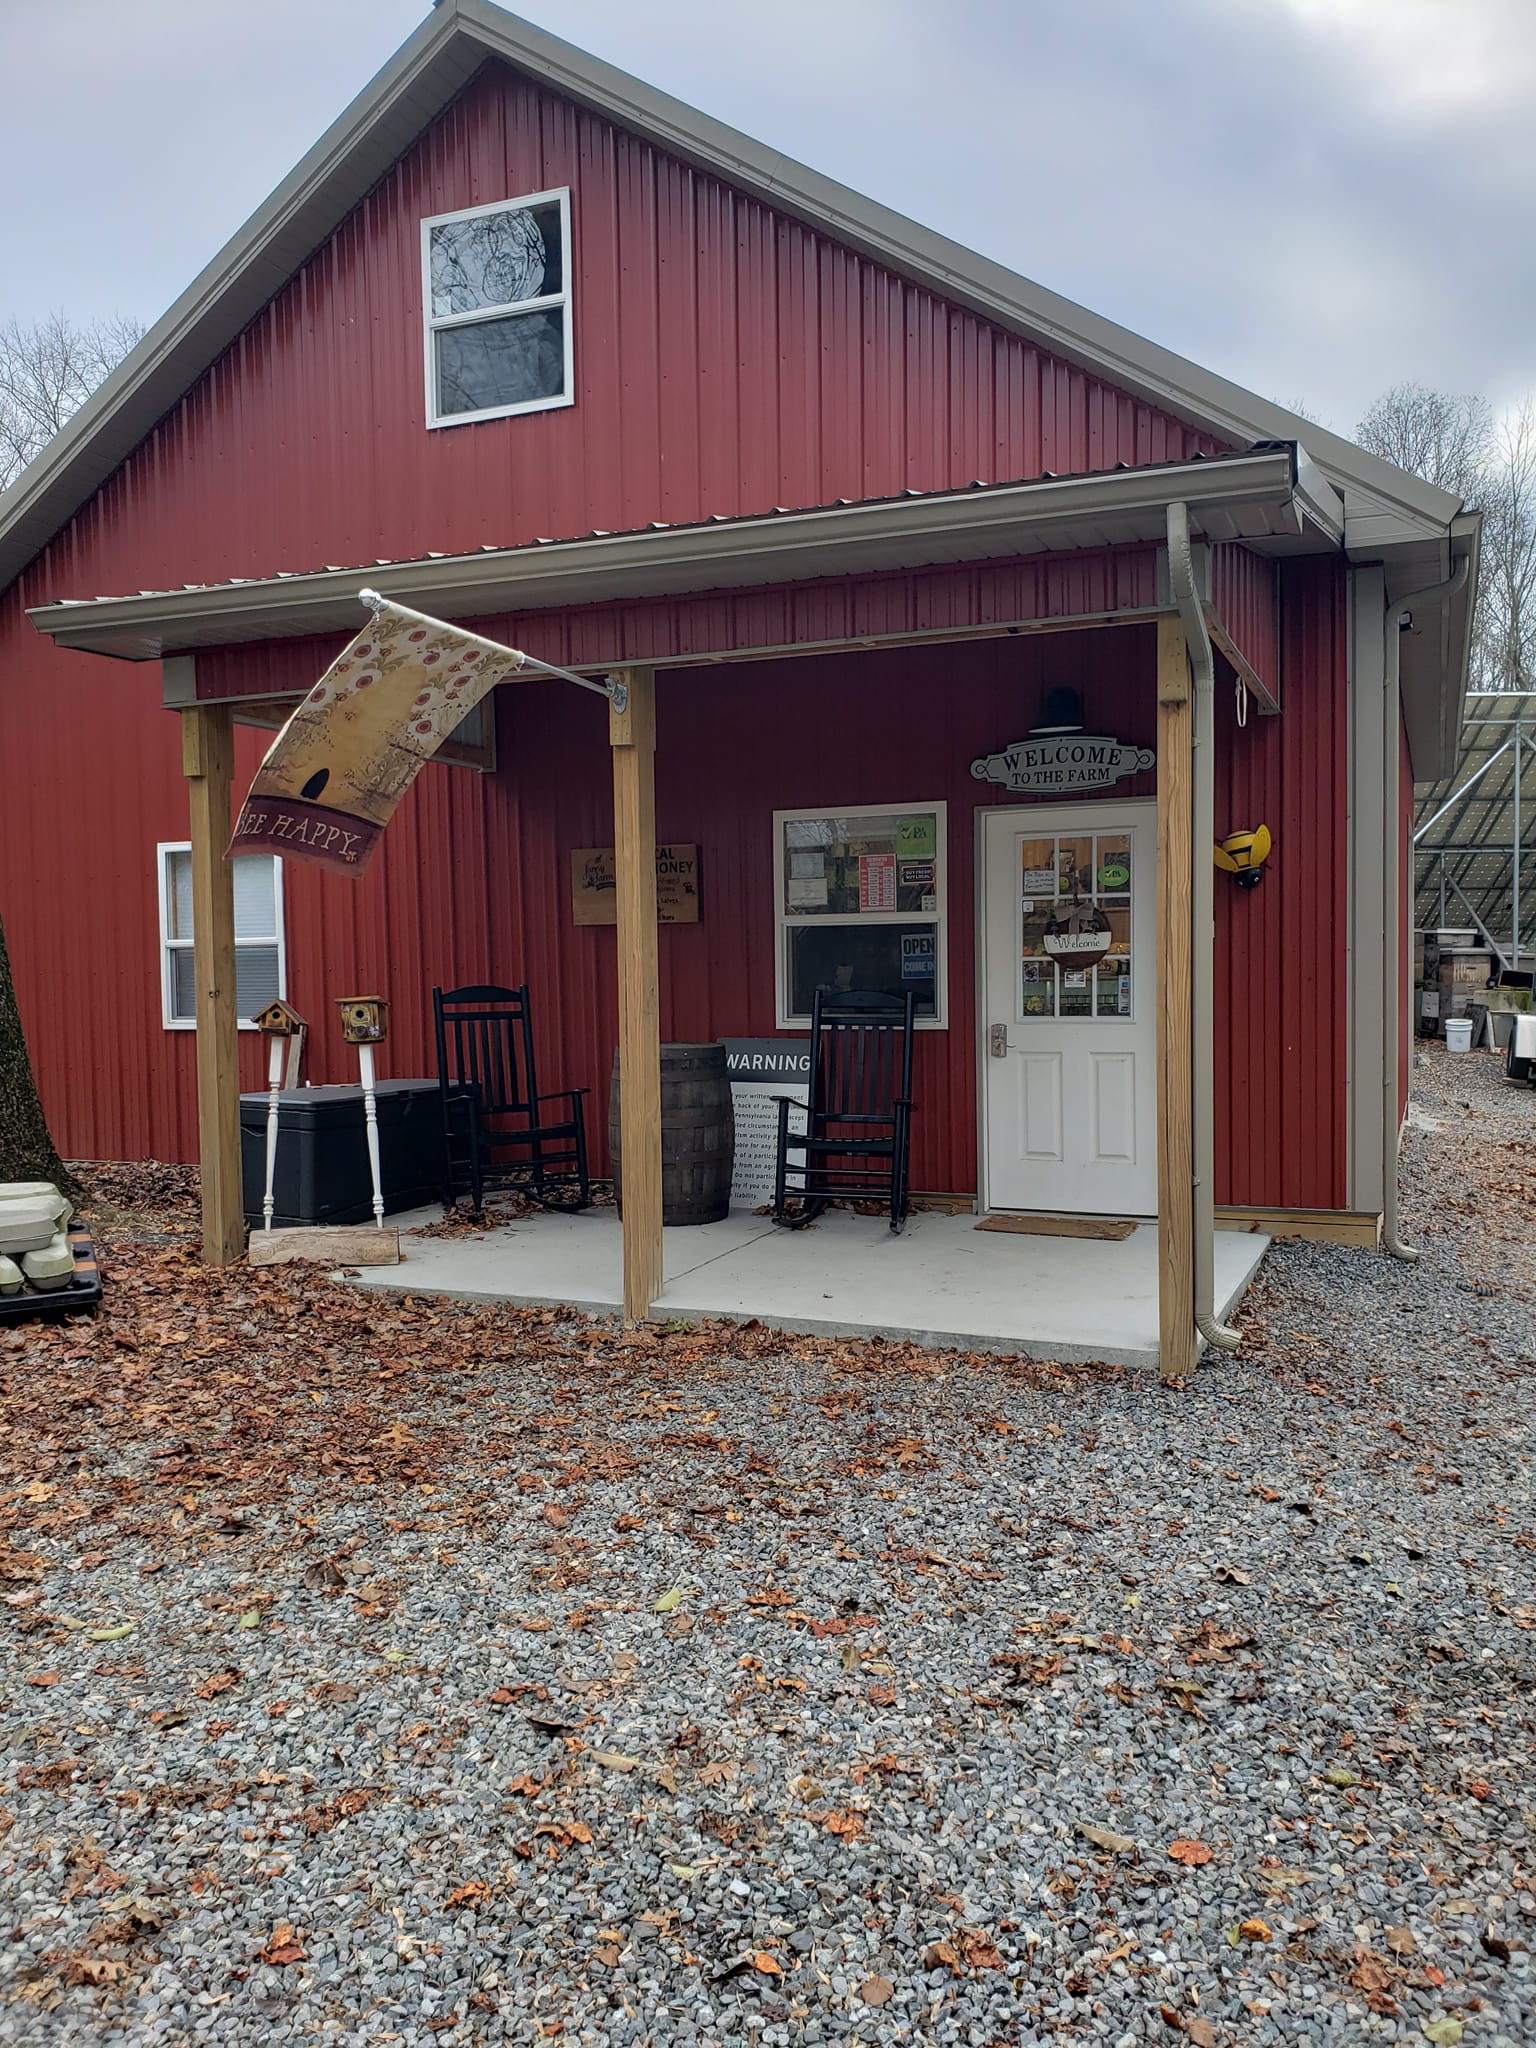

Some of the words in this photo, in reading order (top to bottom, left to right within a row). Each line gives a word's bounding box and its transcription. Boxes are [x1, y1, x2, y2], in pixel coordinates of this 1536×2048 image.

[1002, 746, 1122, 771] WELCOME
[1012, 772, 1031, 785] TO
[1034, 771, 1064, 784] THE
[1068, 768, 1111, 781] FARM
[268, 814, 362, 855] HAPPY
[903, 938, 935, 955] OPEN
[1054, 937, 1101, 949] Welcome
[904, 962, 927, 972] COME
[727, 1053, 811, 1071] WARNING
[735, 1112, 771, 1120] Pennsylvania
[749, 1132, 771, 1140] activity
